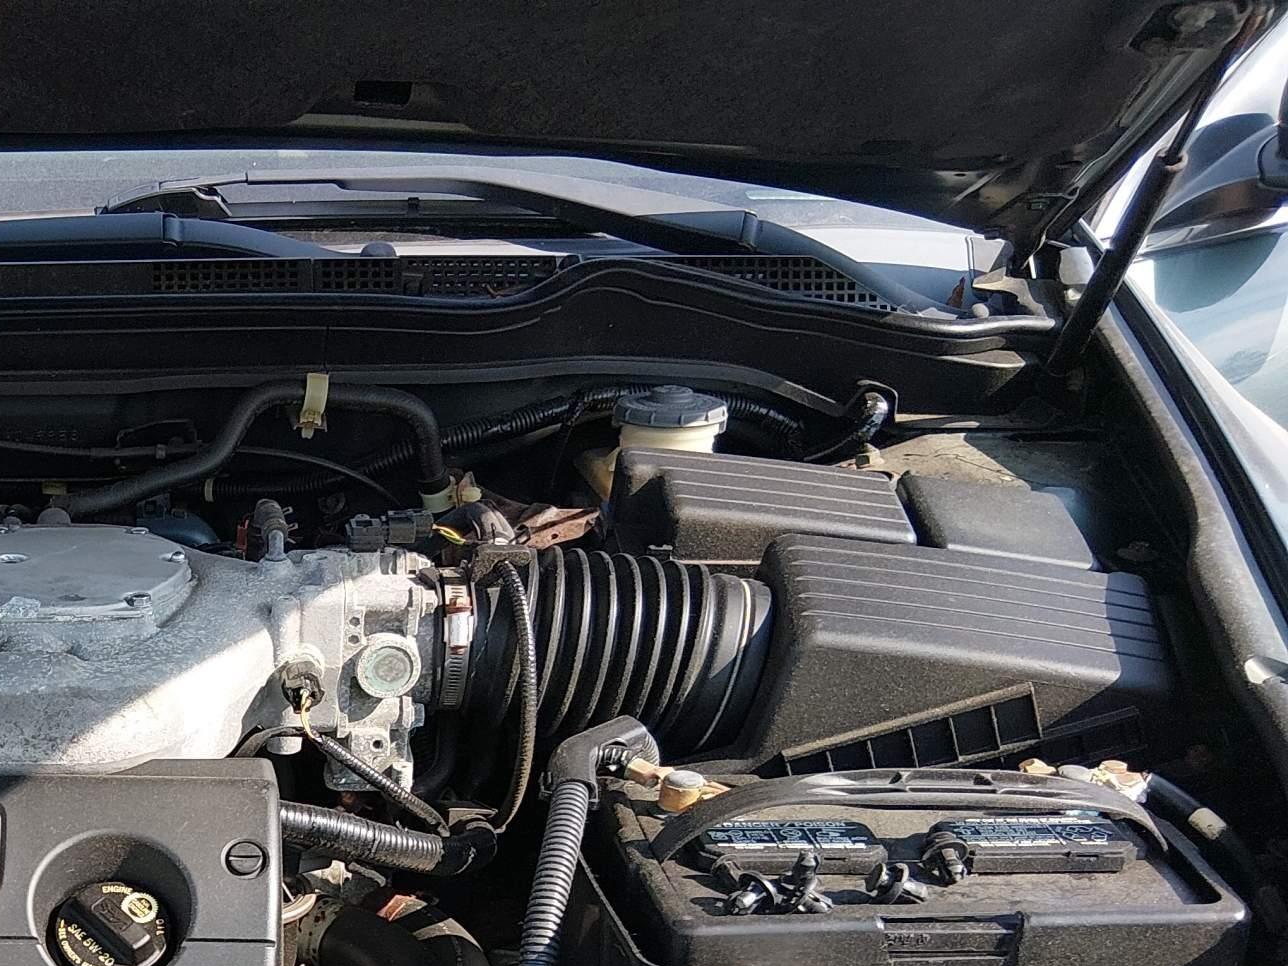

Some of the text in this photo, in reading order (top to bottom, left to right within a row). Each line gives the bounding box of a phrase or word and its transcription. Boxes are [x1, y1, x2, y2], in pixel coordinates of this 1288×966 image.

[102, 885, 133, 894] ENGINE
[155, 918, 165, 935] OIL
[67, 923, 115, 966] SAE 5W-20
